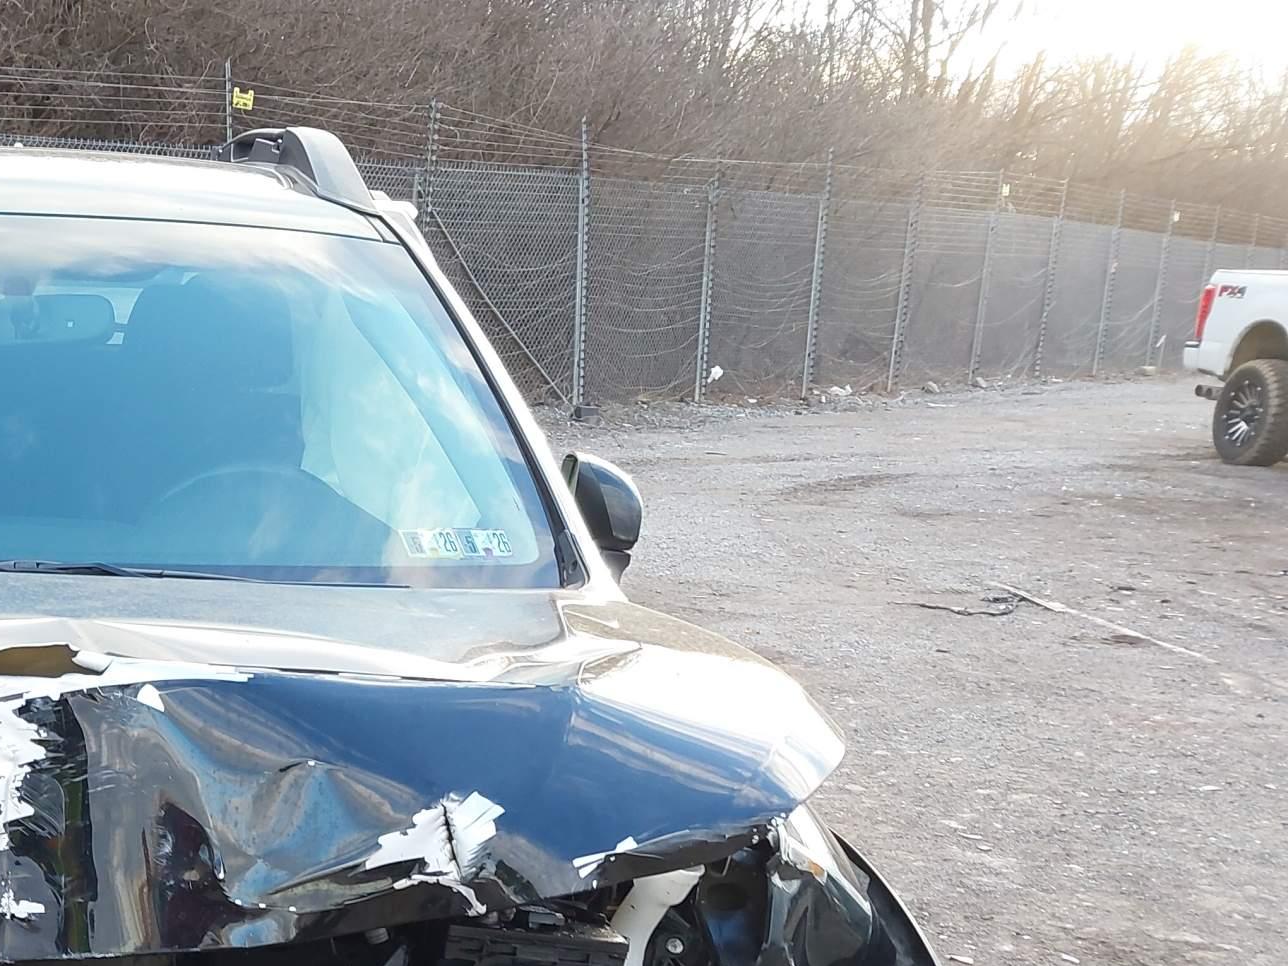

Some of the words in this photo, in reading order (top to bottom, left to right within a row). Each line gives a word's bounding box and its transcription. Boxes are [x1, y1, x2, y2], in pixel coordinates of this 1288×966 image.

[1218, 285, 1248, 297] FX4
[439, 532, 458, 553] 26
[492, 532, 512, 553] 26
